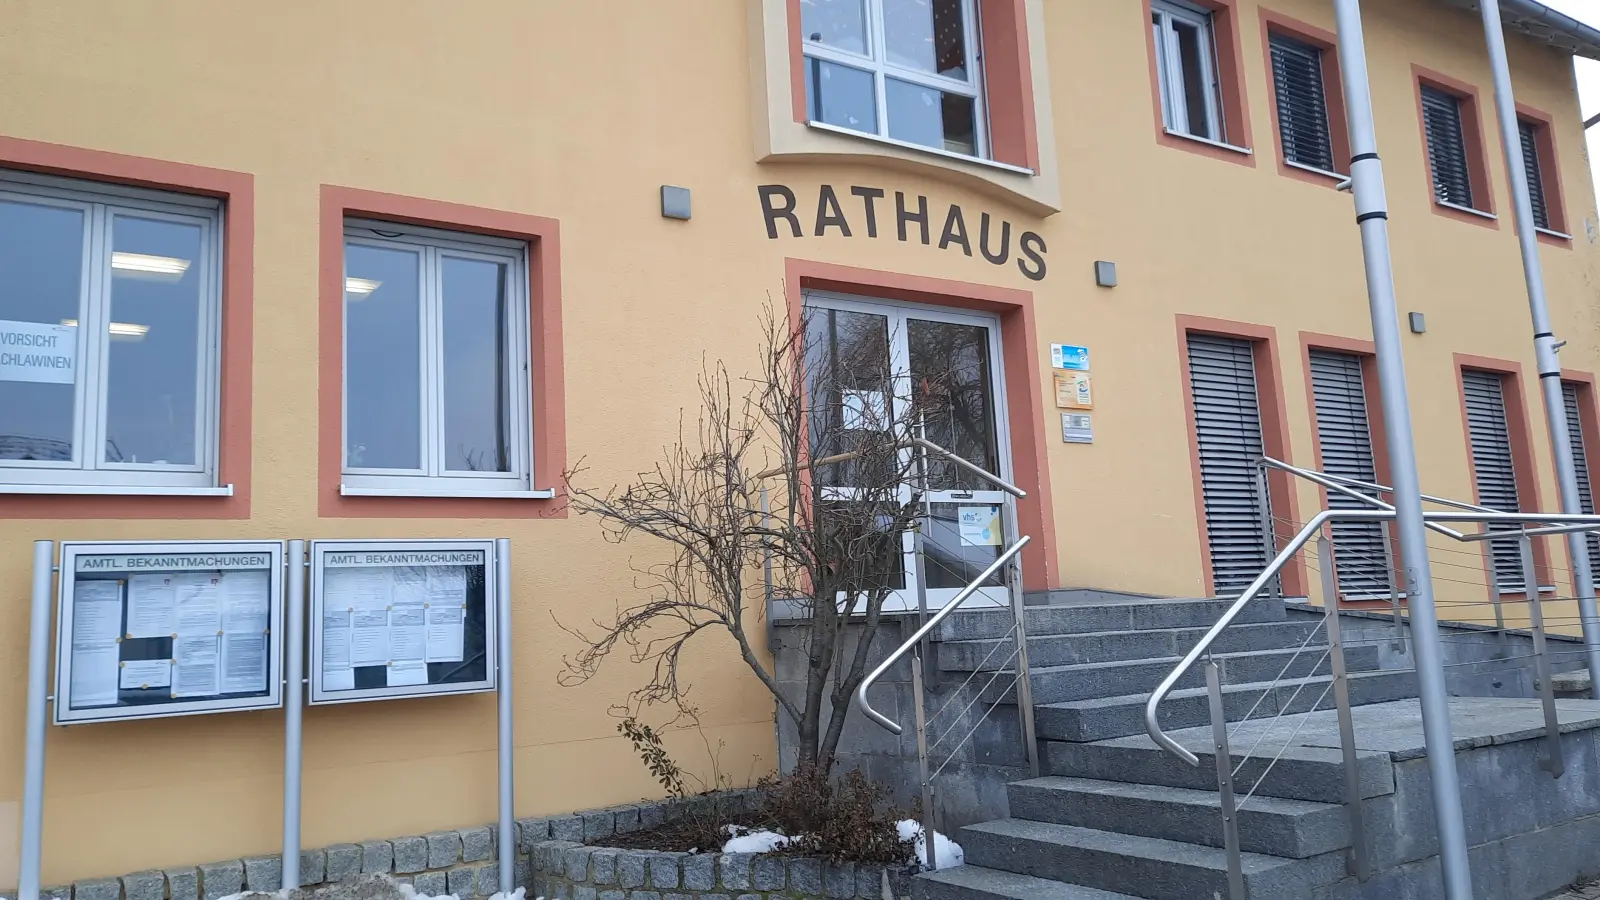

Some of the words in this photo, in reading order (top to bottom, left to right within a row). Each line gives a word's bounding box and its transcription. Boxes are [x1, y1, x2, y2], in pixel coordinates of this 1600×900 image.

[757, 184, 1047, 281] RATHAUS
[0, 332, 58, 348] VORSICHT
[0, 352, 72, 369] CHLAWINEN
[962, 513, 976, 521] vhs
[83, 558, 123, 568] AMTL.
[127, 556, 265, 568] BEKANNTMACHUNGEN
[330, 555, 362, 565] AMTL.
[366, 553, 480, 564] BEKANNTMACHUNGEN
